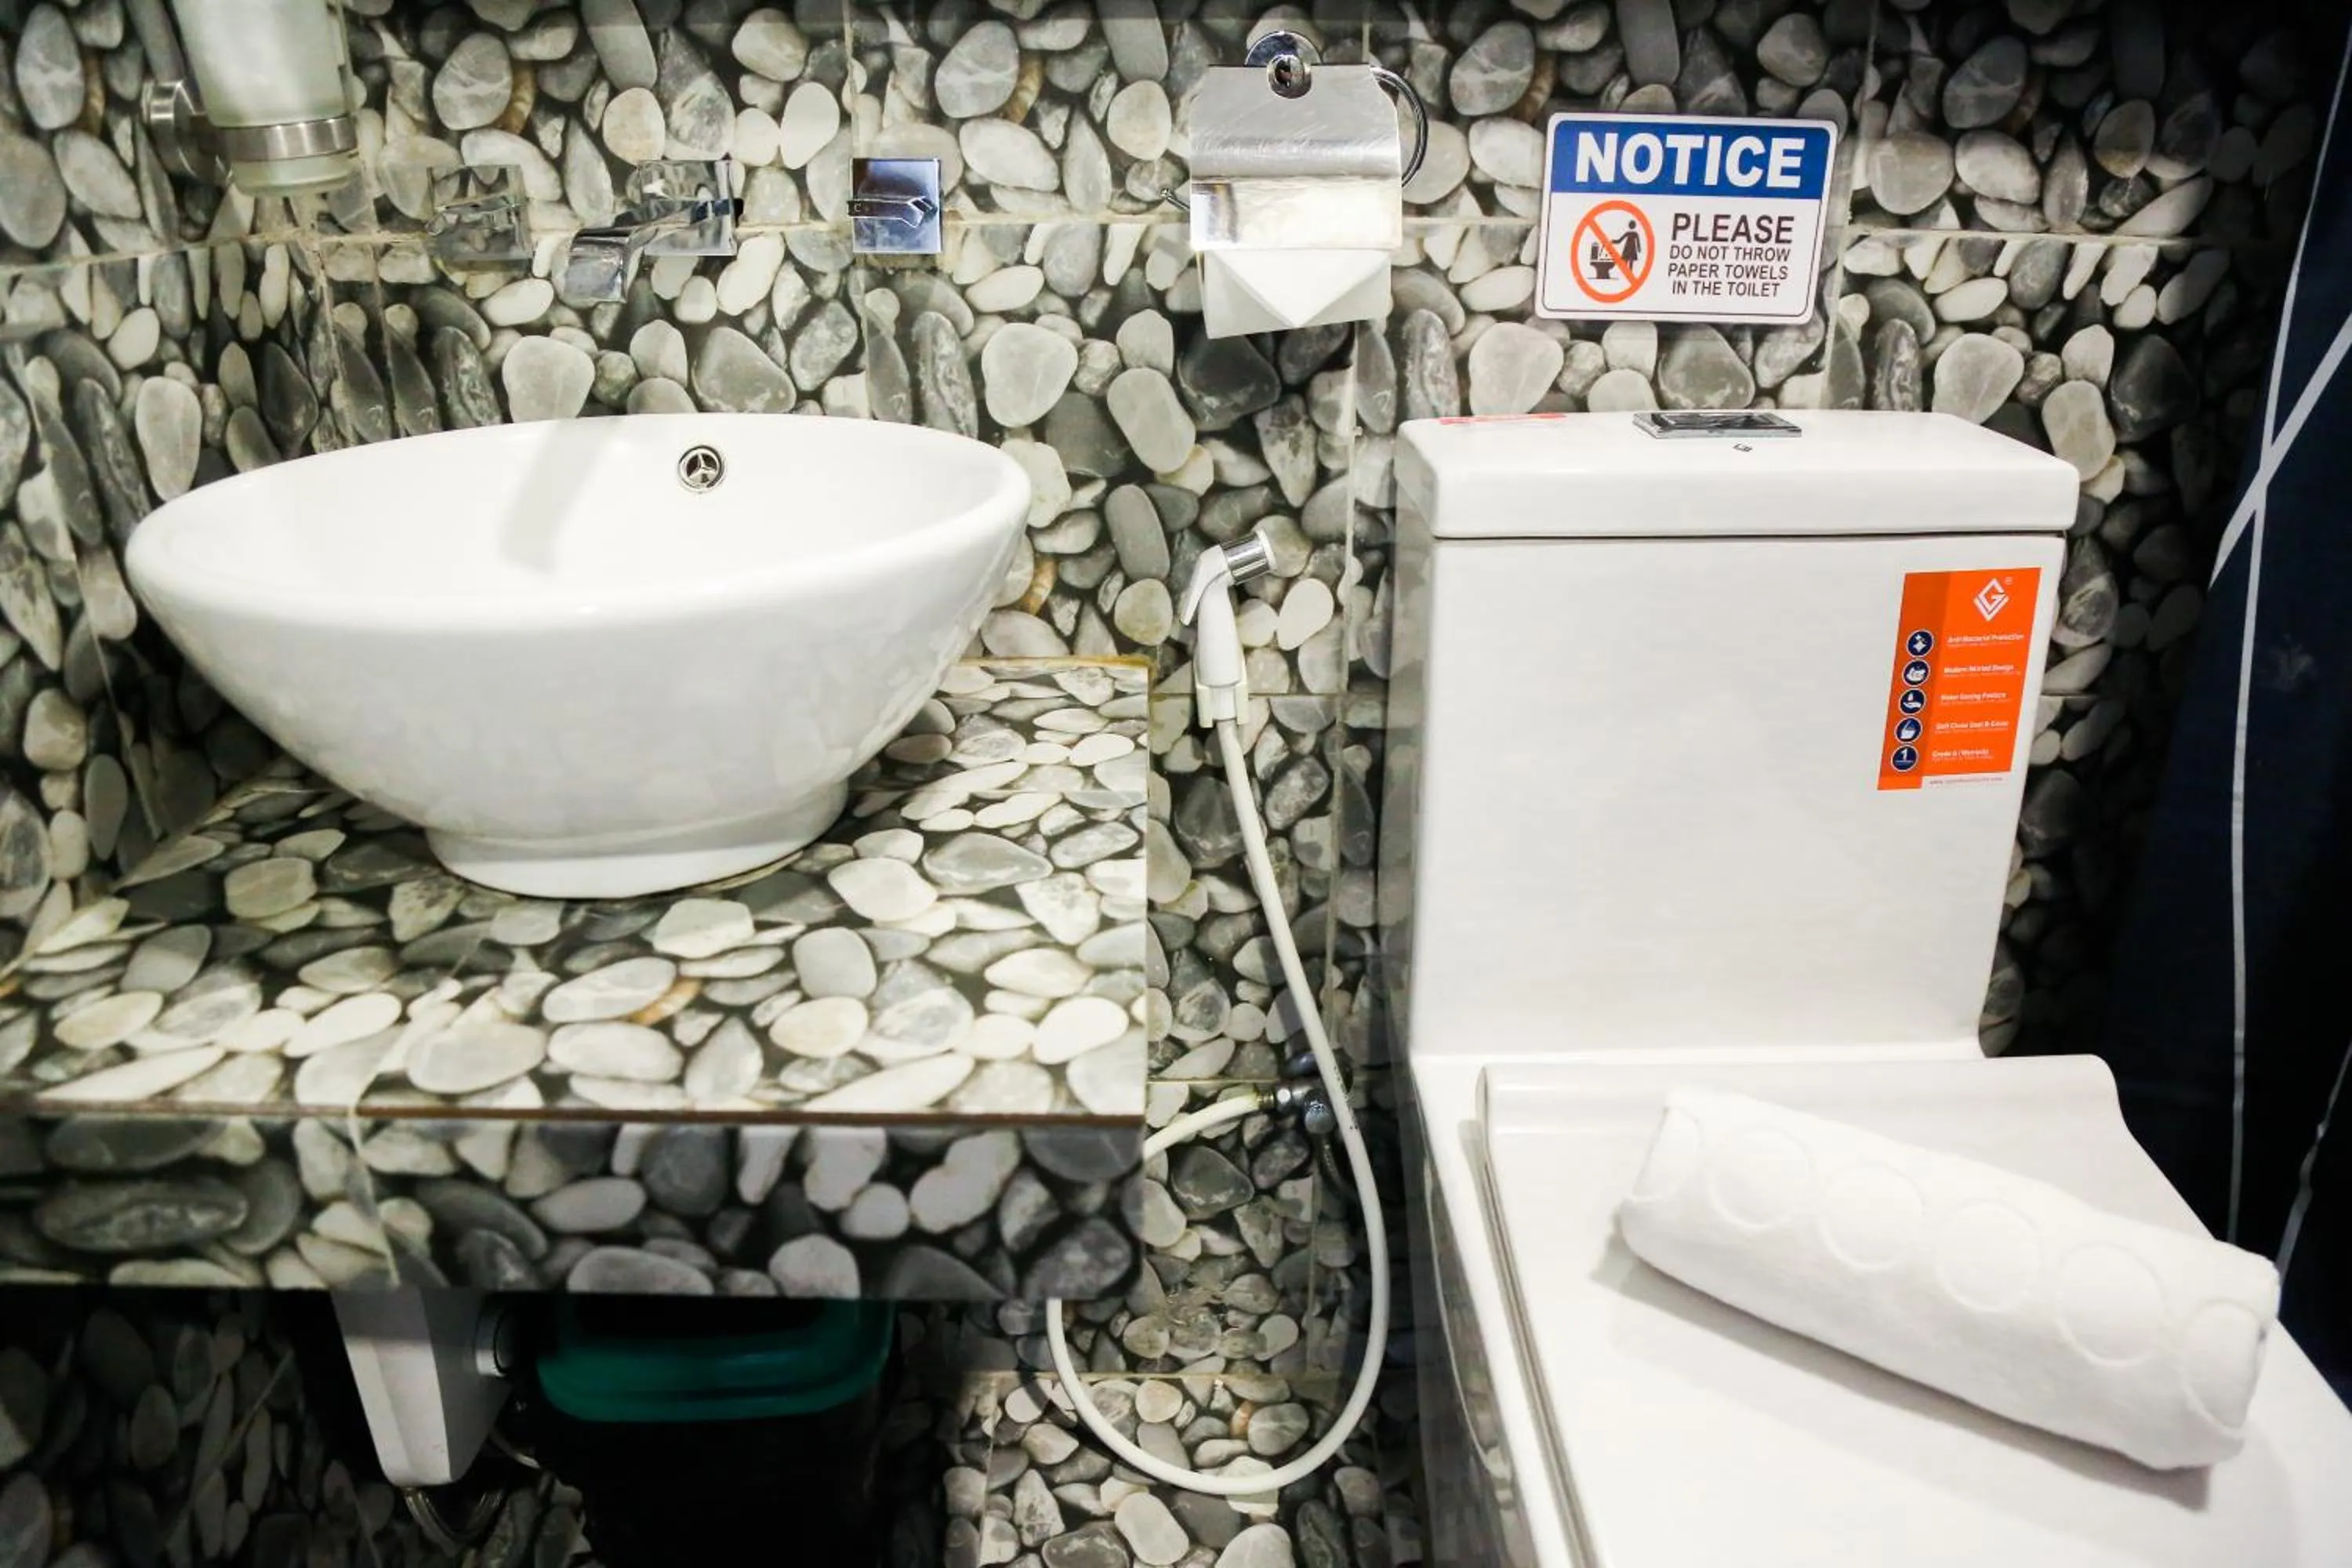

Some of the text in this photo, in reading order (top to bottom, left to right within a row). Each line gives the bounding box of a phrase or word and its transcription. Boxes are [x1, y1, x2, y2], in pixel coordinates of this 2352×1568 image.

[1575, 131, 1806, 188] NOTICE
[1671, 212, 1795, 244] PLEASE
[1669, 245, 1791, 262] DO NOT THROW
[1668, 263, 1788, 280] PAPER TOWELS
[1671, 280, 1780, 297] IN THE TOILET
